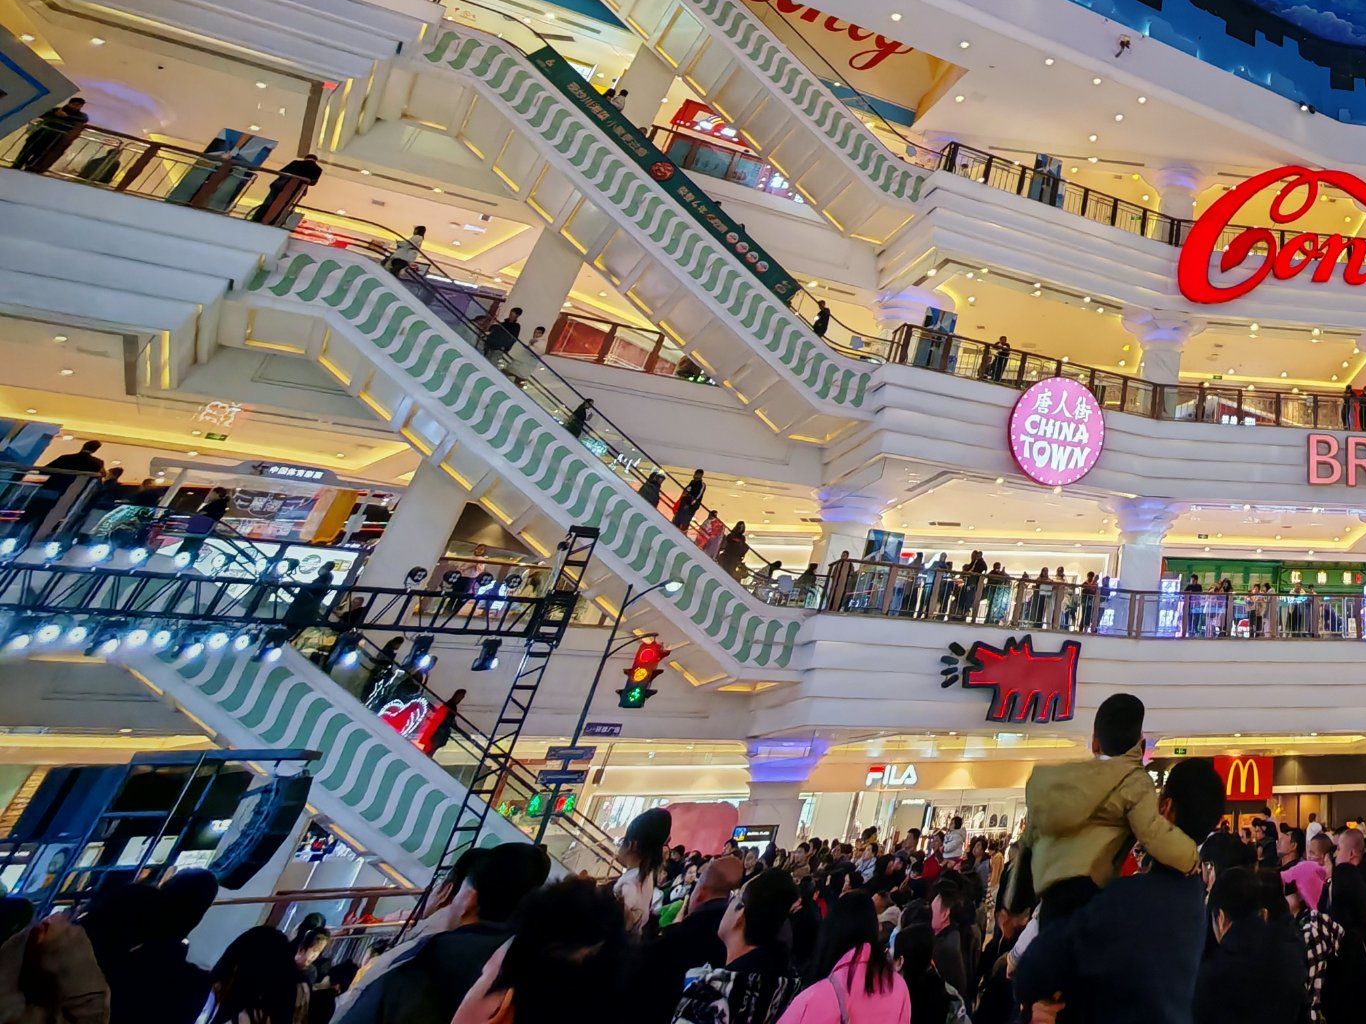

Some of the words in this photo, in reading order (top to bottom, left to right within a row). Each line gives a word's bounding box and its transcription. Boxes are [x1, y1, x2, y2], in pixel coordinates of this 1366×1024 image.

[1024, 414, 1090, 444] CHINA
[1020, 433, 1092, 472] TOWN
[865, 763, 918, 787] FILA
[1226, 759, 1259, 795] M
